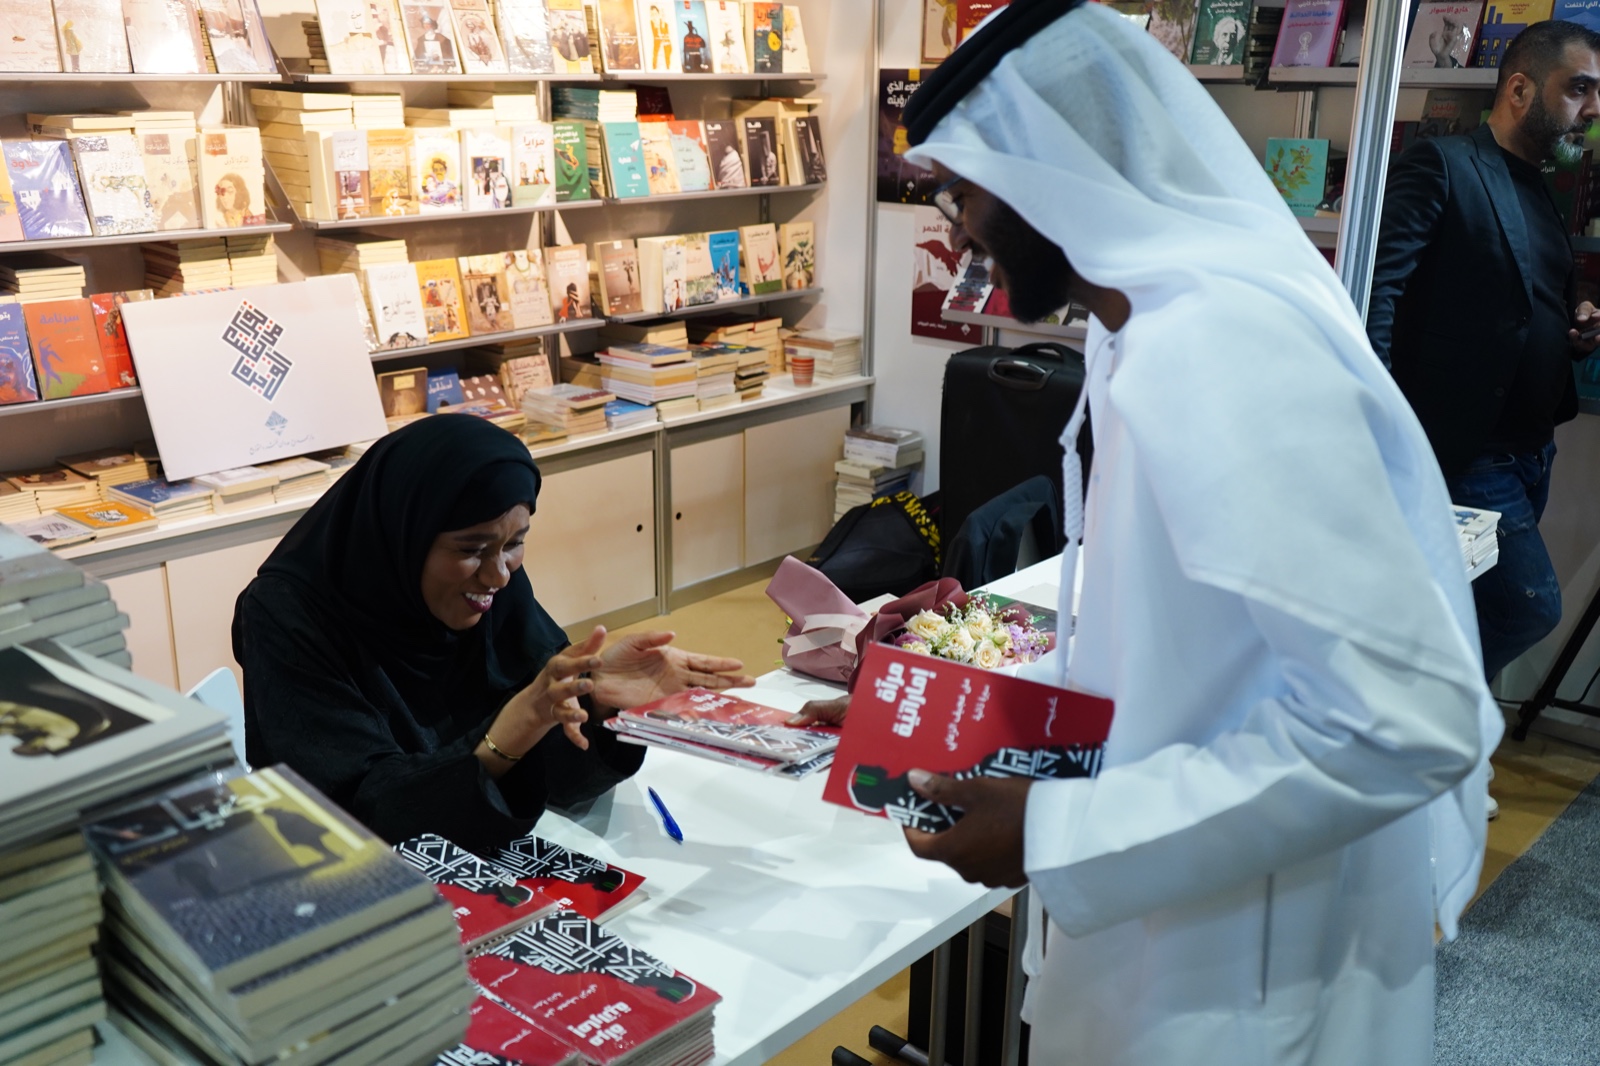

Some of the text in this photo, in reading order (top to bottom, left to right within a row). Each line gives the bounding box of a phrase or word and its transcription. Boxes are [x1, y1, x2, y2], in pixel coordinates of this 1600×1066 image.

[1429, 6, 1468, 14] خارج الأسوار
[887, 81, 904, 94] الذي
[40, 313, 79, 324] سرنامة
[944, 678, 972, 752] منى عجيف الزعابي
